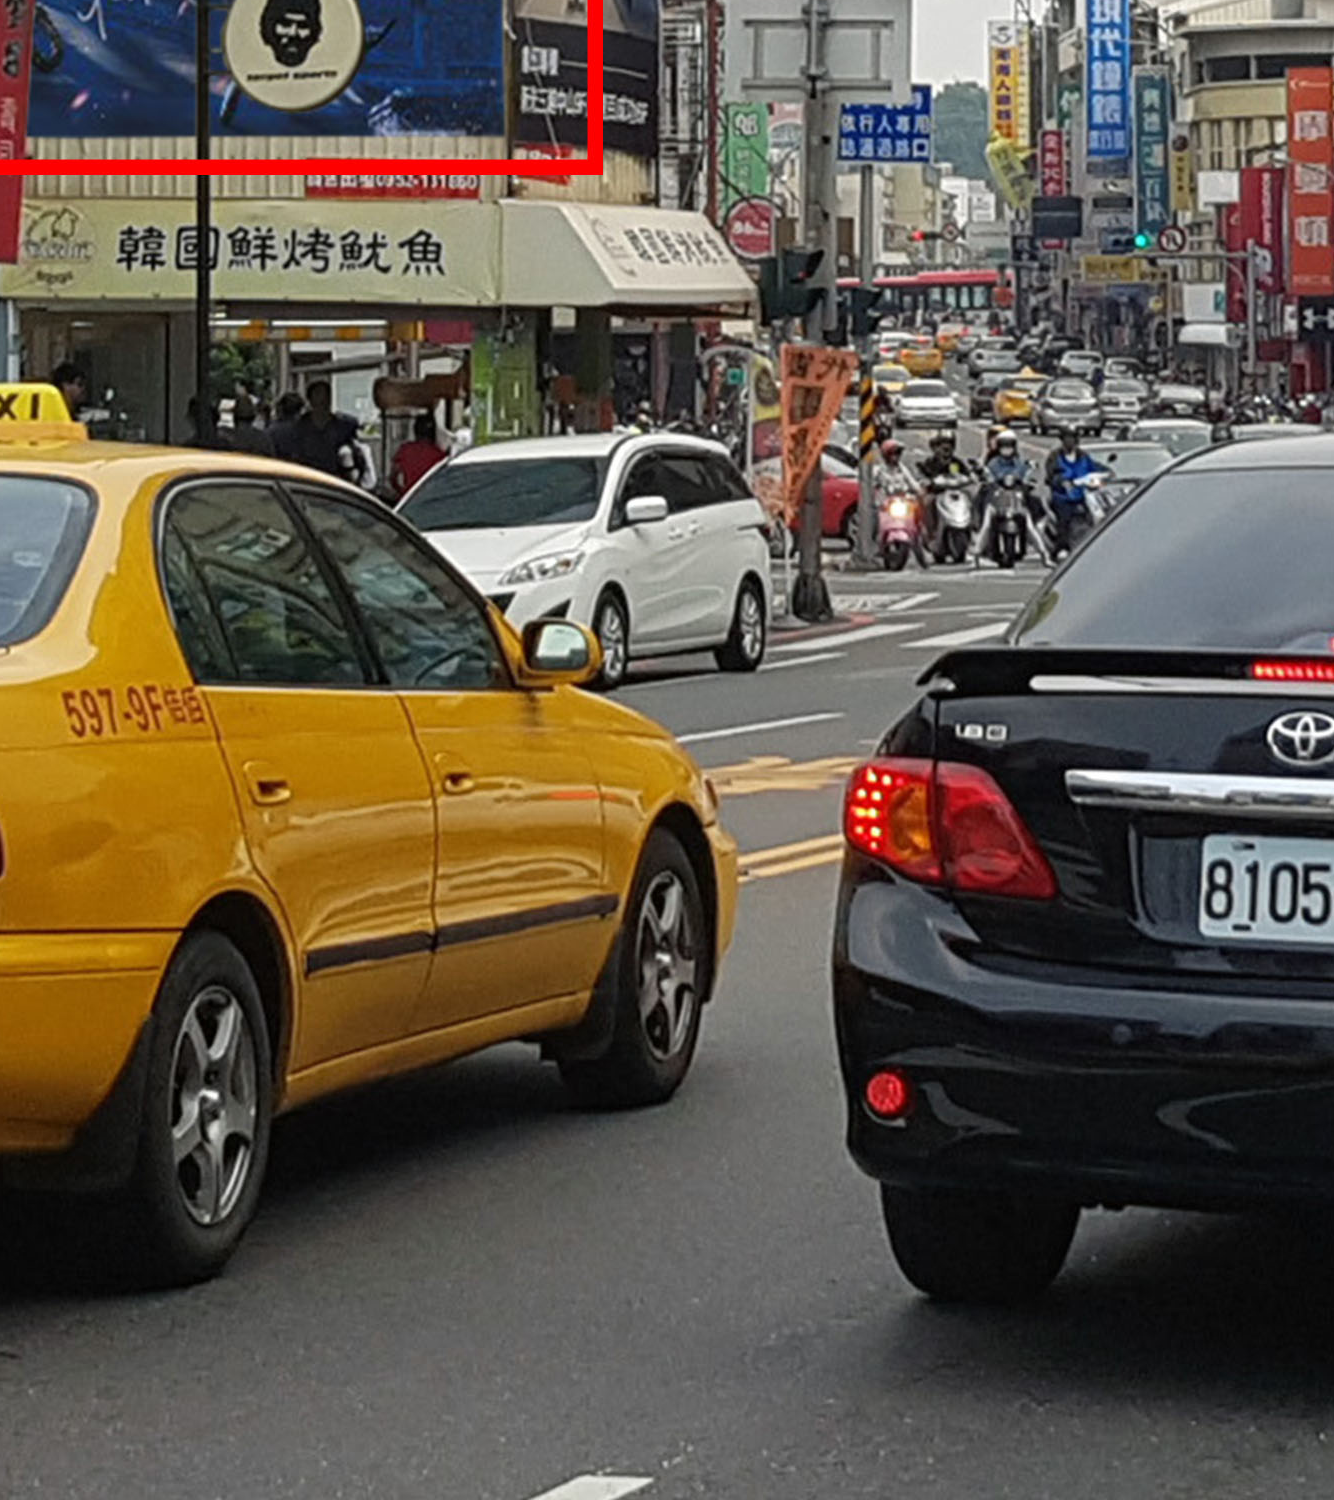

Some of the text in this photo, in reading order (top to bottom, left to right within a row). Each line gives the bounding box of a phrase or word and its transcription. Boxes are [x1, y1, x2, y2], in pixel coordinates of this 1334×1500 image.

[115, 225, 446, 277] 韓國鮮烤魷魚
